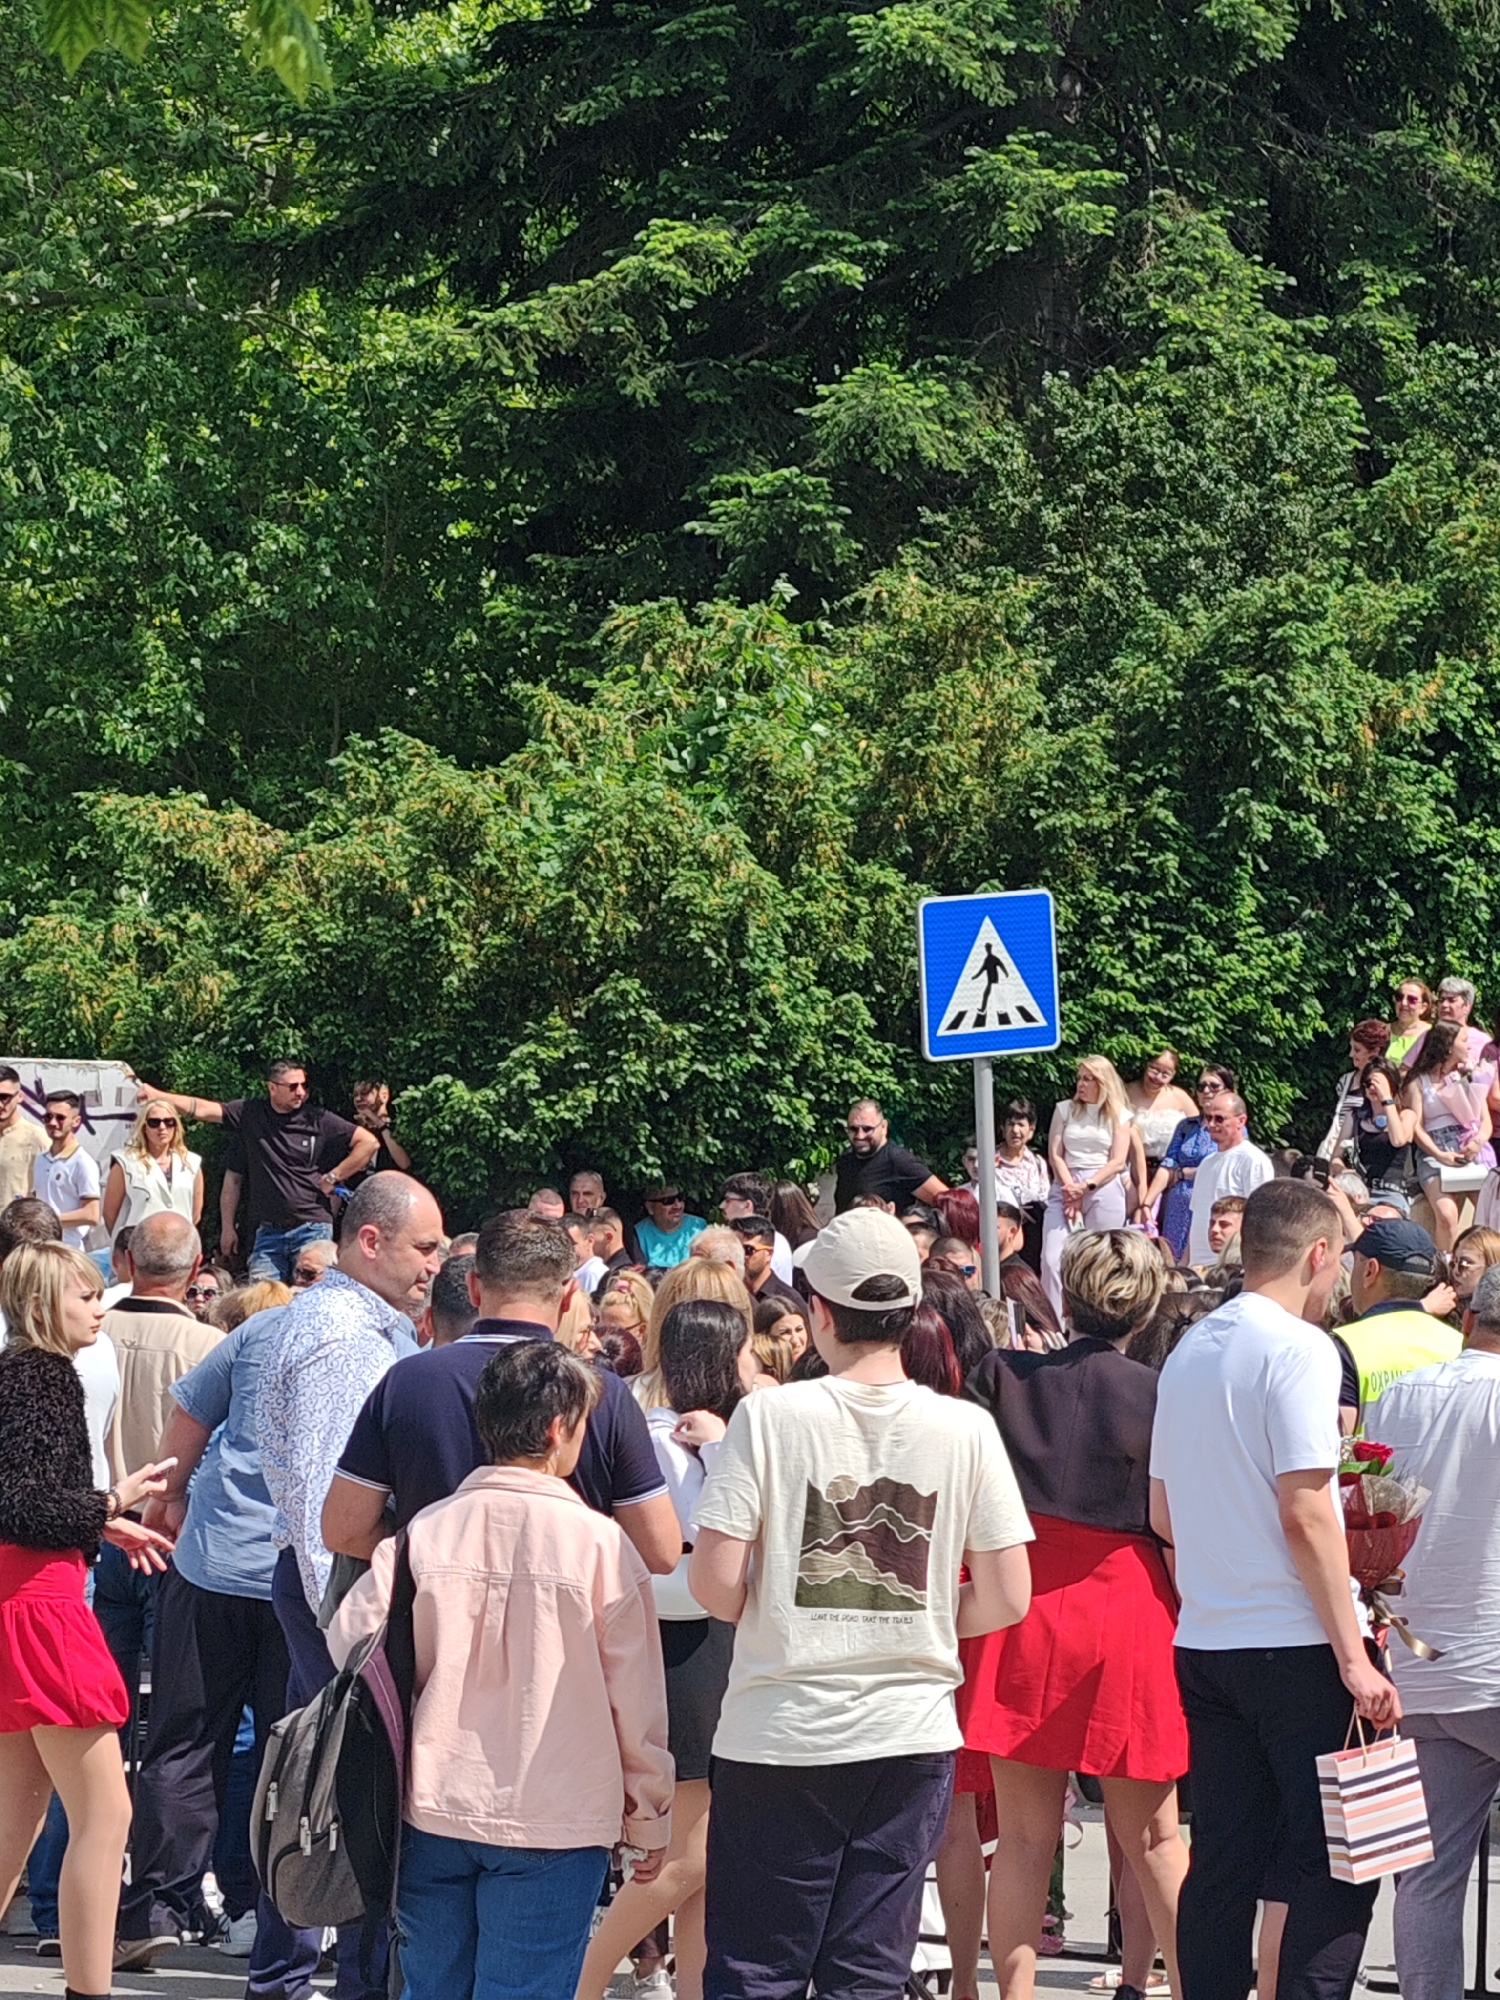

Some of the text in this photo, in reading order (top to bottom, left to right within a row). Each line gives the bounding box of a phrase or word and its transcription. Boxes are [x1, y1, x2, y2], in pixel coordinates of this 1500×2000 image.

[811, 1612, 827, 1621] LEAVE
[829, 1613, 839, 1622] THE
[862, 1615, 877, 1624] TAKE
[878, 1616, 890, 1624] THE
